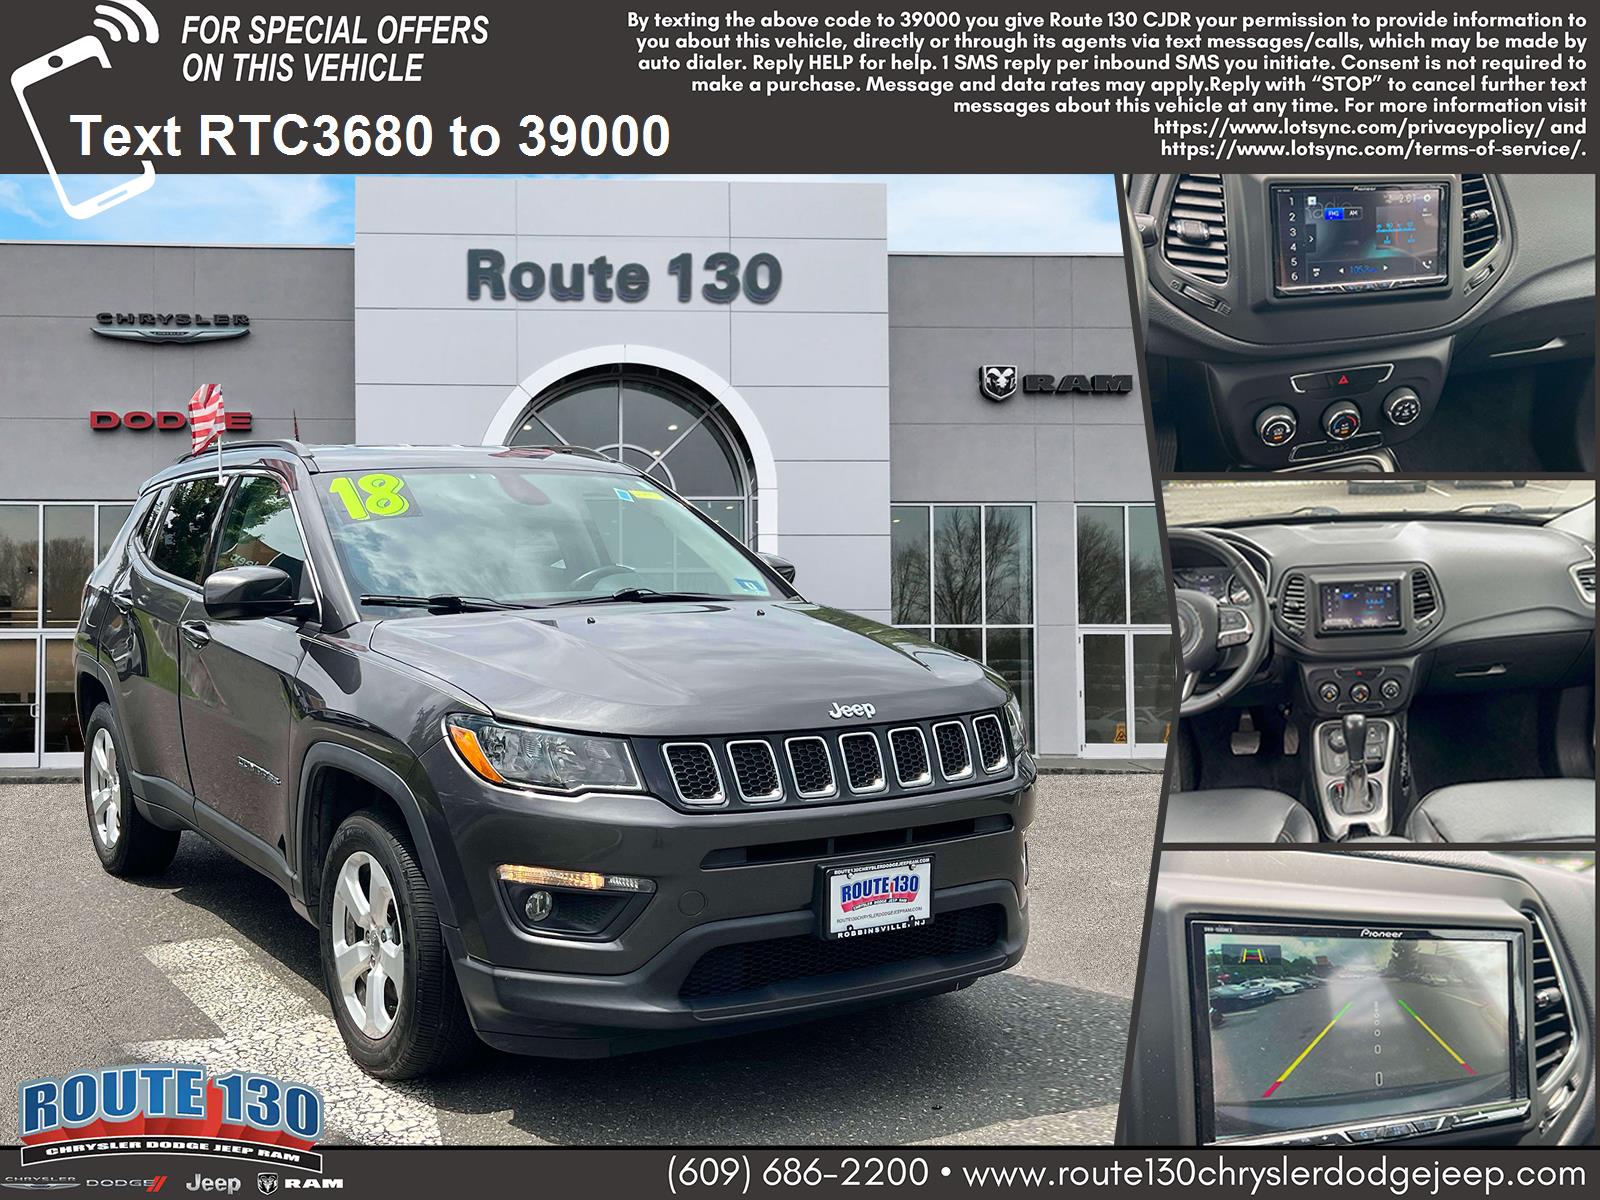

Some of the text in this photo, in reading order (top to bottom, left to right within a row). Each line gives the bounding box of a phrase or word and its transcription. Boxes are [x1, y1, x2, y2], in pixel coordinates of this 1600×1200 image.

[1289, 197, 1294, 206] 1
[1289, 213, 1296, 222] 2
[1289, 228, 1297, 237] 3
[1290, 243, 1297, 251] 4
[1290, 258, 1298, 267] 5
[467, 248, 782, 304] Route 130
[1291, 272, 1298, 281] 6
[96, 313, 250, 325] CHRYSLER
[1023, 375, 1133, 394] RAM
[90, 411, 252, 431] DODE
[329, 473, 410, 520] 18
[828, 702, 876, 719] Jeep
[842, 875, 920, 903] ROUTE 130
[837, 919, 926, 939] ROBBINSVILLE, NJ
[1360, 928, 1404, 938] Pioneer
